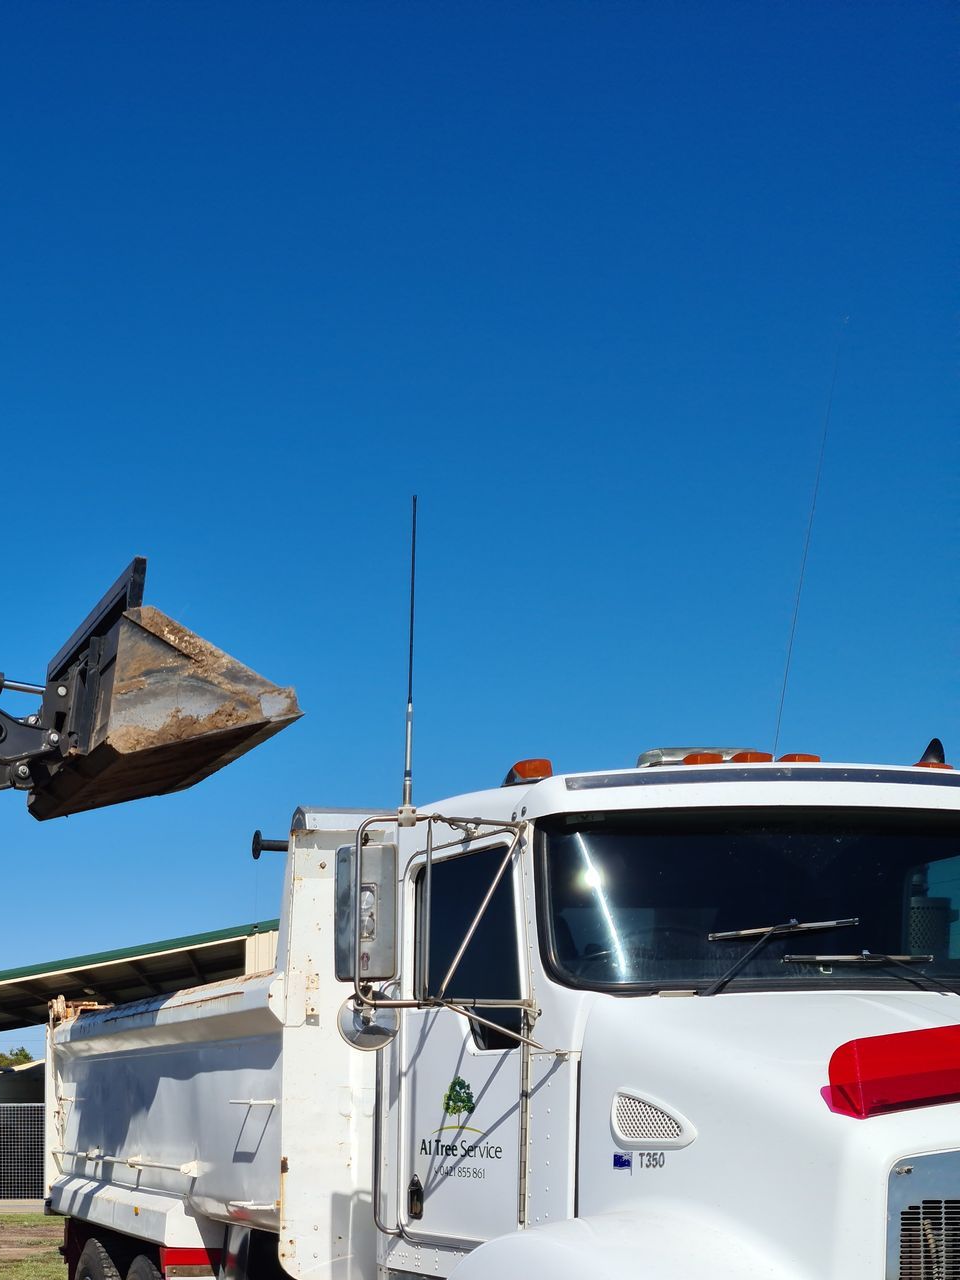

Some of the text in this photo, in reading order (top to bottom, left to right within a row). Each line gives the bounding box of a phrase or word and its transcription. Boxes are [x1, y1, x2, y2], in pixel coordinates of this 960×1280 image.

[420, 1139, 503, 1160] A1 Tree Service
[638, 1152, 665, 1169] T350
[440, 1165, 486, 1179] 0421 855 861
